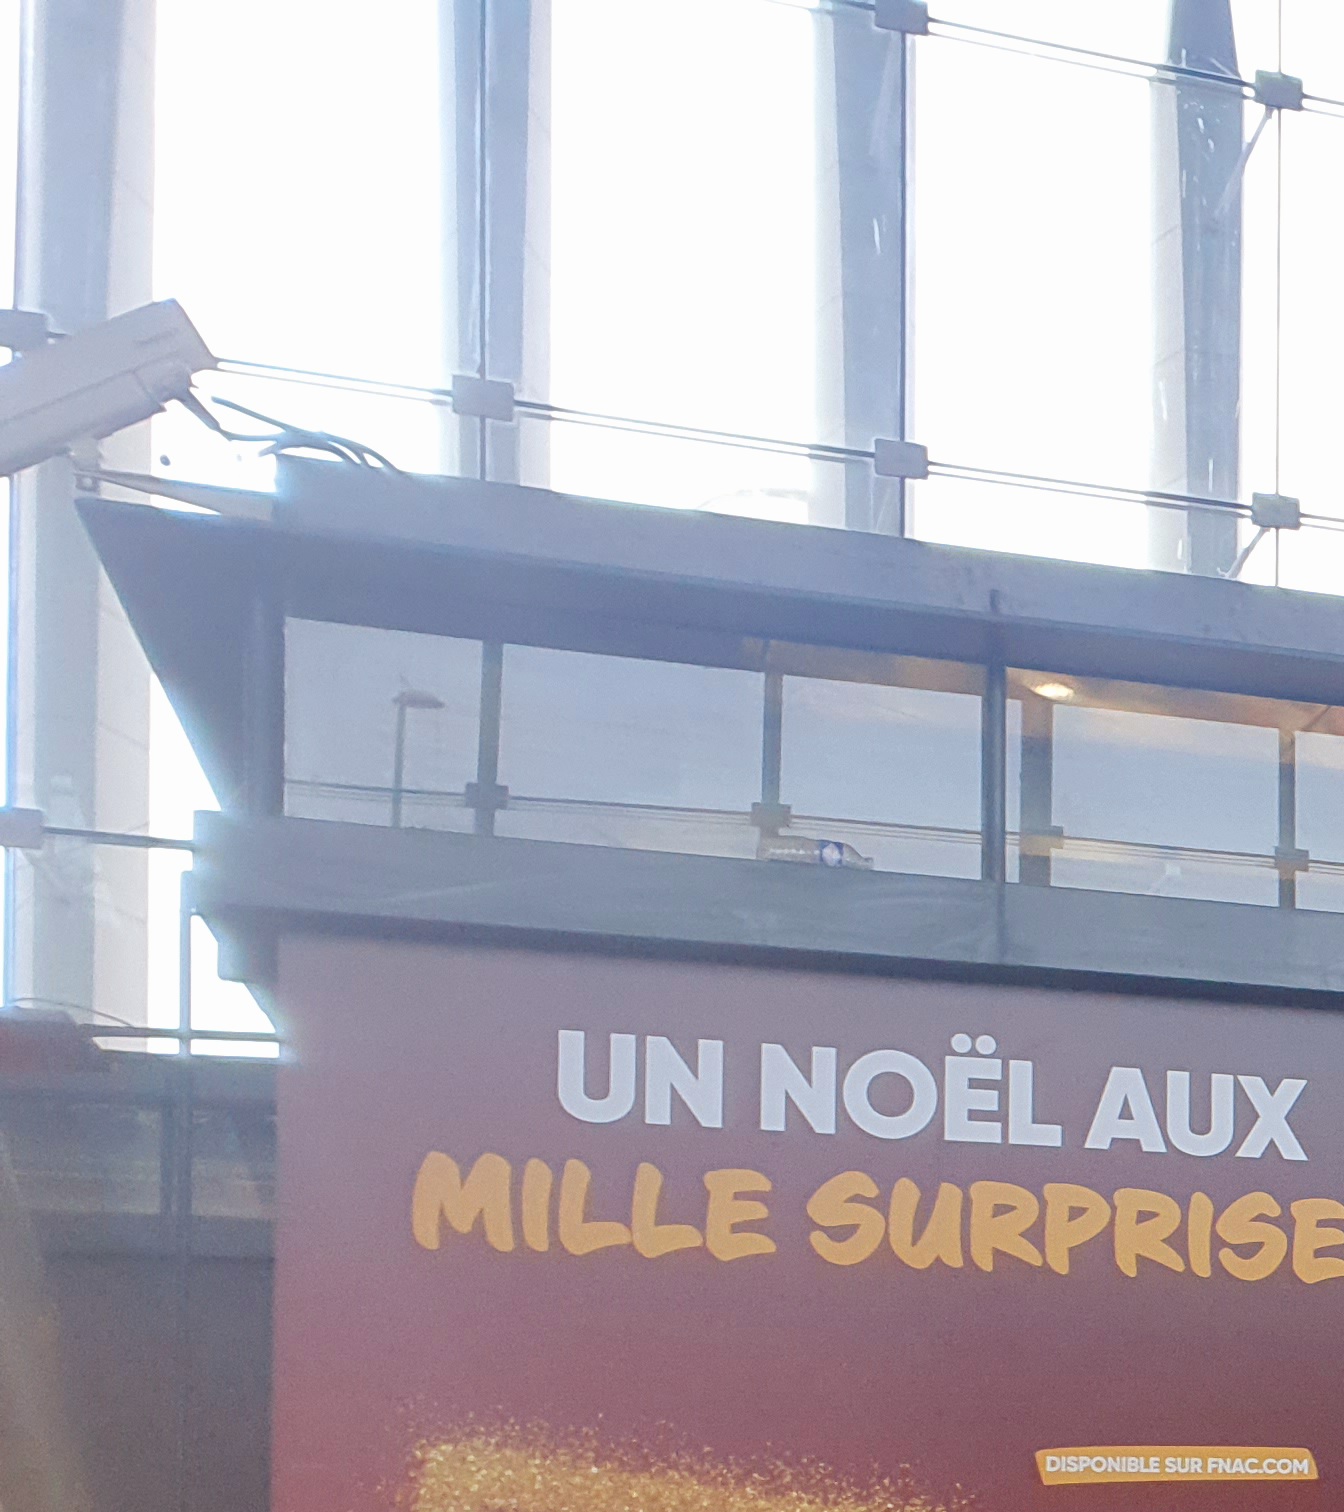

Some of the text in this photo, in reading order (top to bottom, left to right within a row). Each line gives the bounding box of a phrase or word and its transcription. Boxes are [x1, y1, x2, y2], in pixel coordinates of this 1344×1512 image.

[557, 1028, 1309, 1161] UN NOËL AUX
[411, 1151, 776, 1260] MILLE
[1045, 1455, 1309, 1475] DISPONIBLE SUR FNAC.COM
